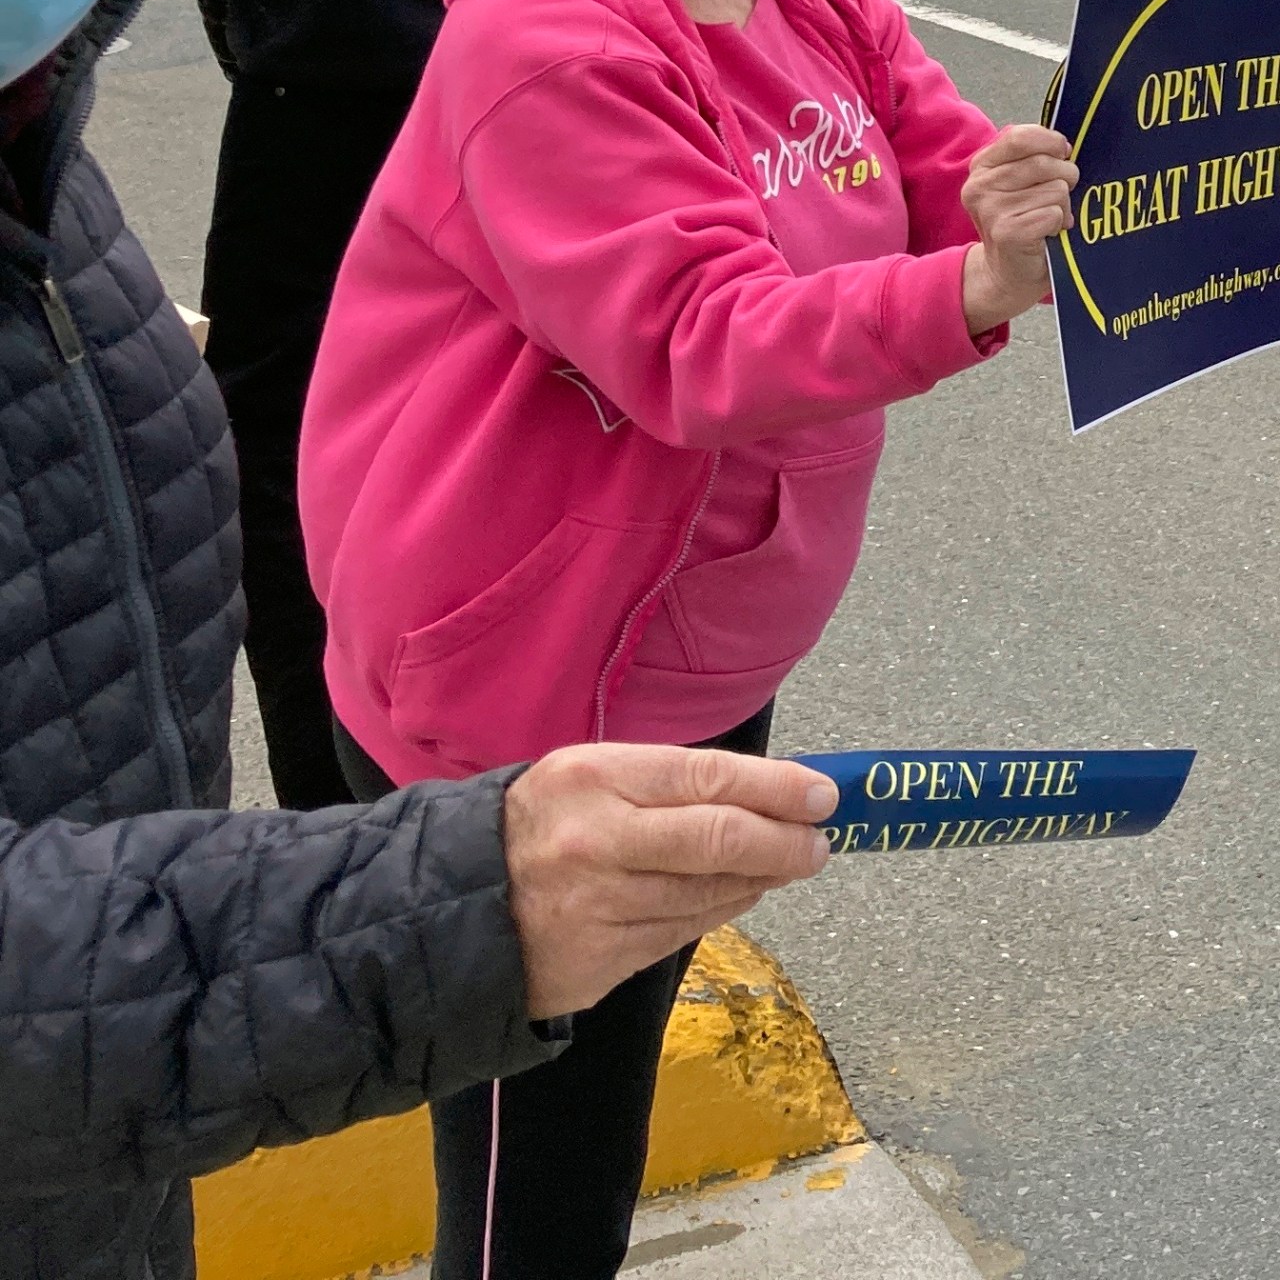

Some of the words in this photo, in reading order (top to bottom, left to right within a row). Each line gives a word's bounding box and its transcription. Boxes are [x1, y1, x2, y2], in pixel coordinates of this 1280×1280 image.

[1136, 62, 1228, 130] OPEN
[1079, 165, 1189, 245] GREAT
[865, 760, 988, 801] OPEN
[998, 760, 1084, 798] THE
[928, 810, 1130, 850] HIGHWAY
